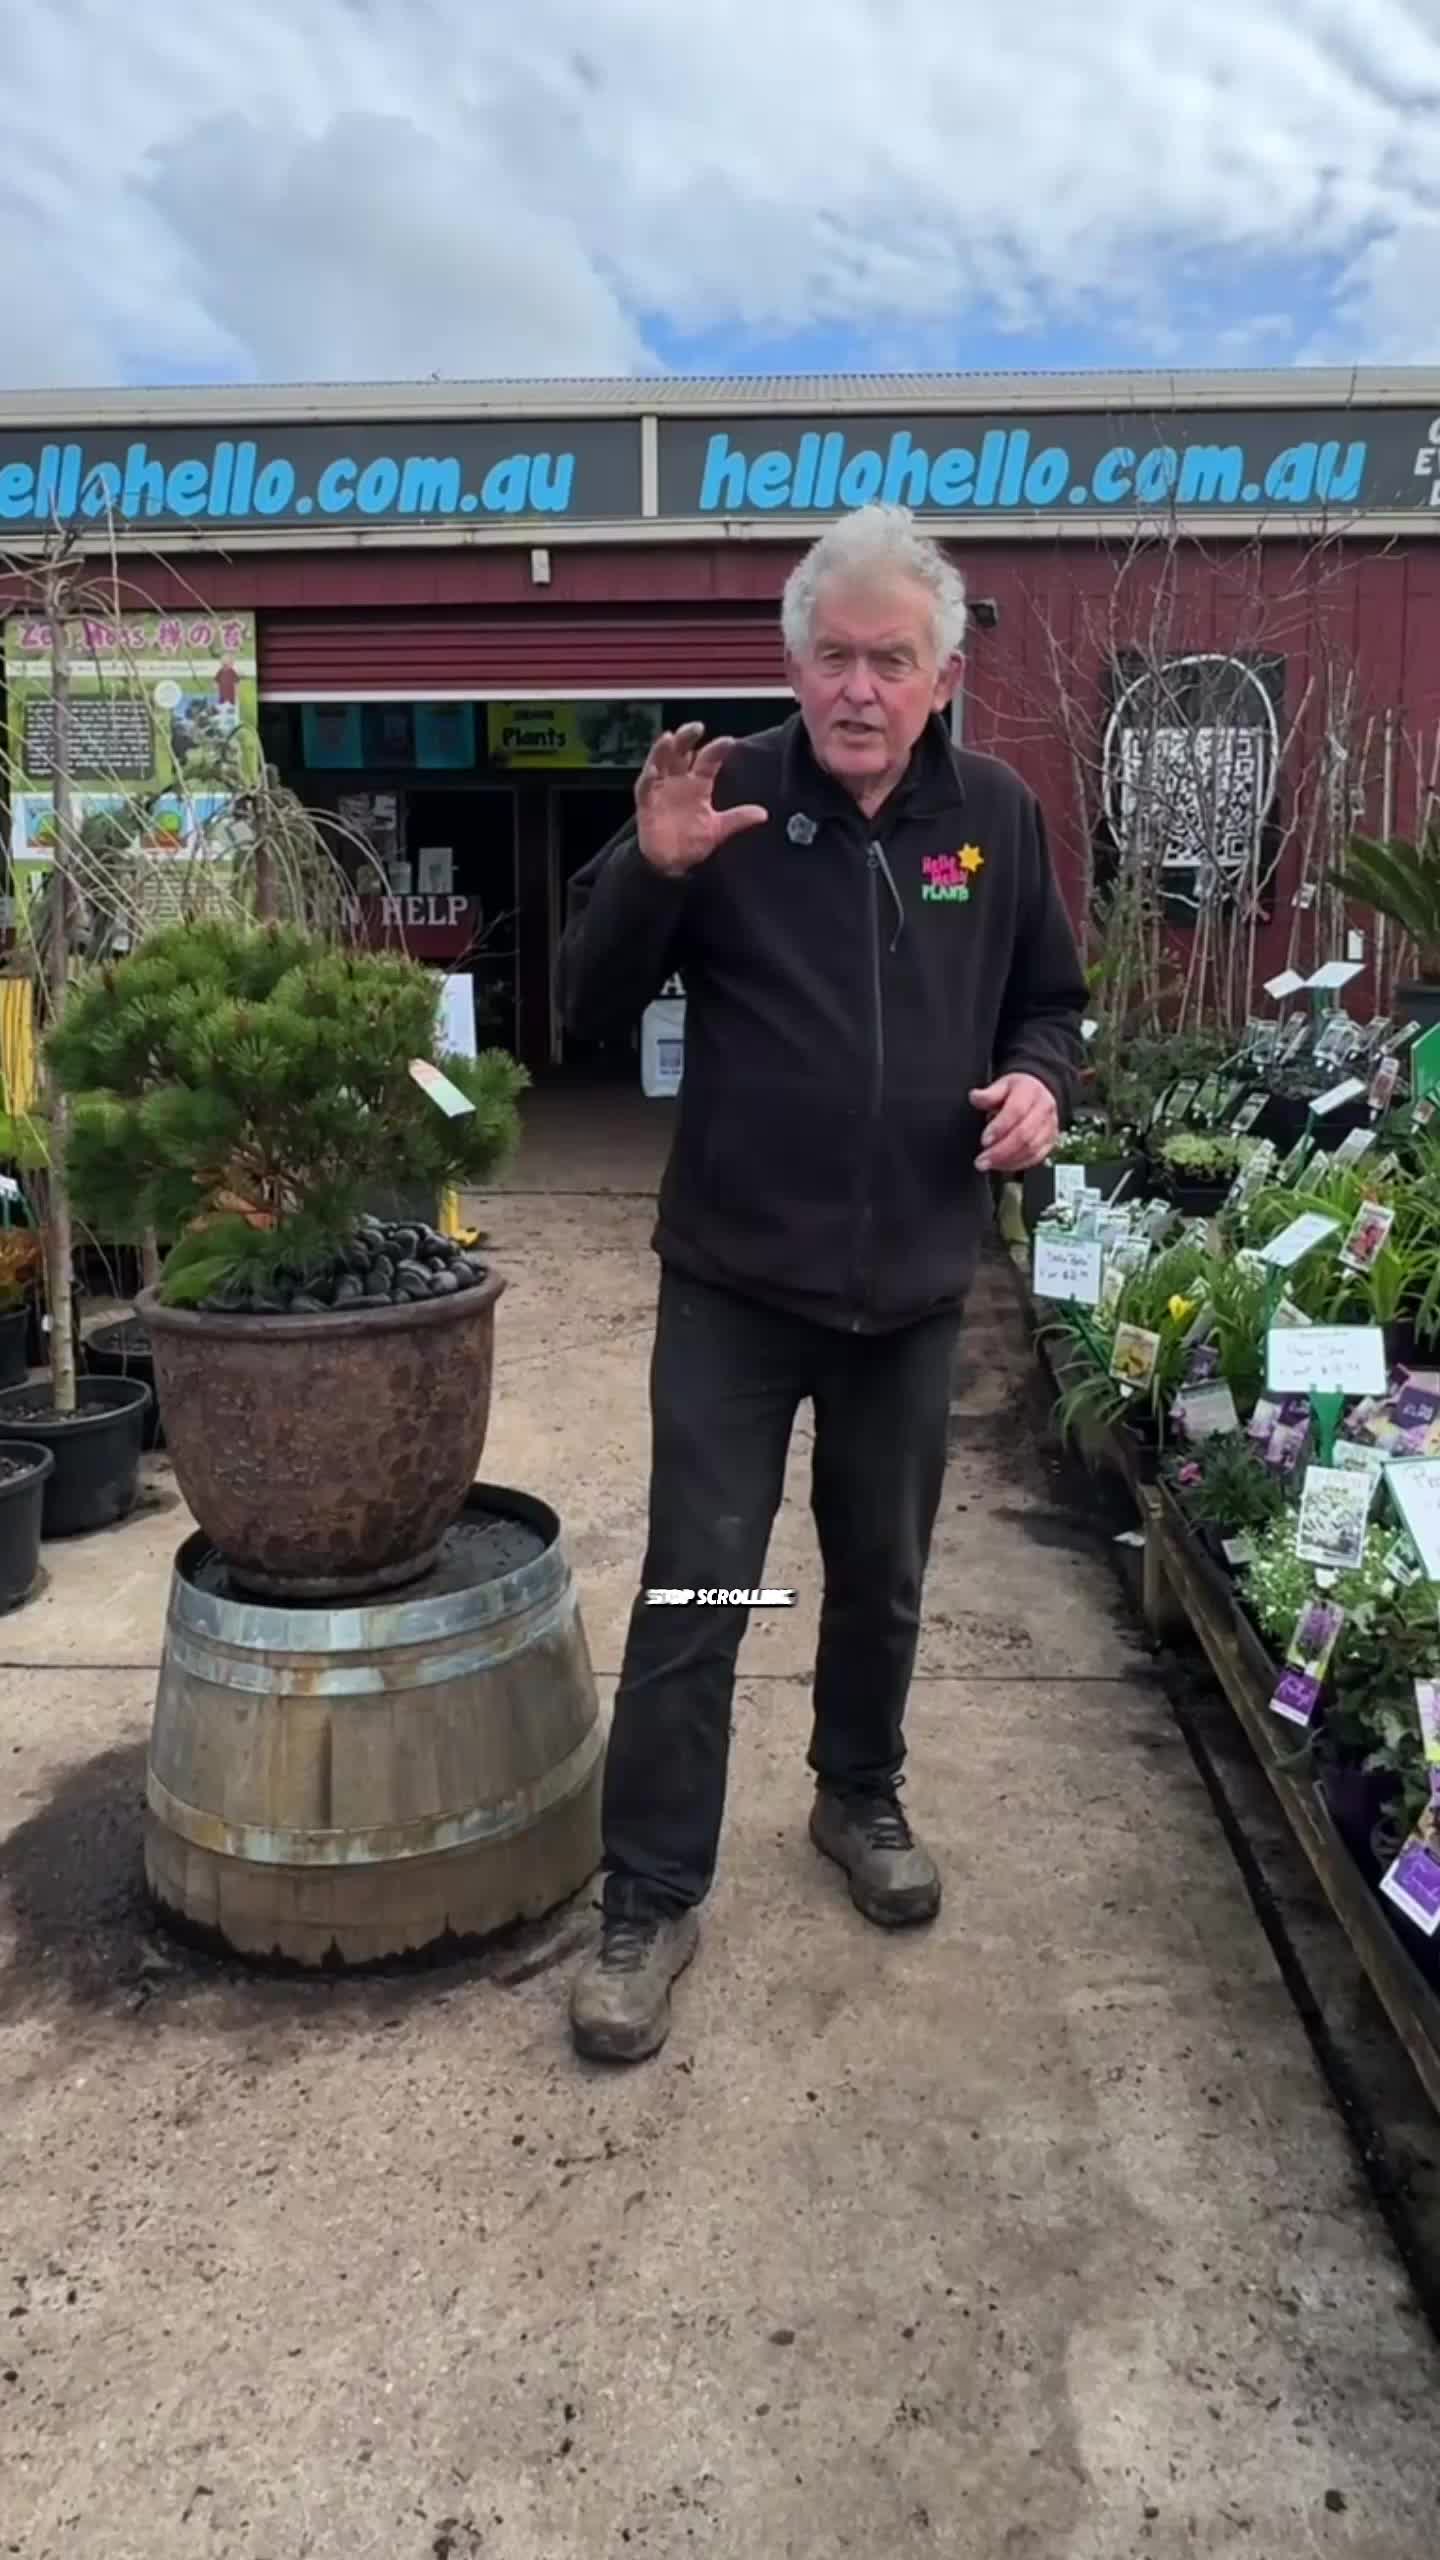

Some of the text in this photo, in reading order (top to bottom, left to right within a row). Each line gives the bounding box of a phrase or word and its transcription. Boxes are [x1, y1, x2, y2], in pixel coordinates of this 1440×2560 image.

[699, 430, 1366, 510] hellohello.com.au
[502, 727, 566, 748] Plants
[381, 896, 468, 926] HELP
